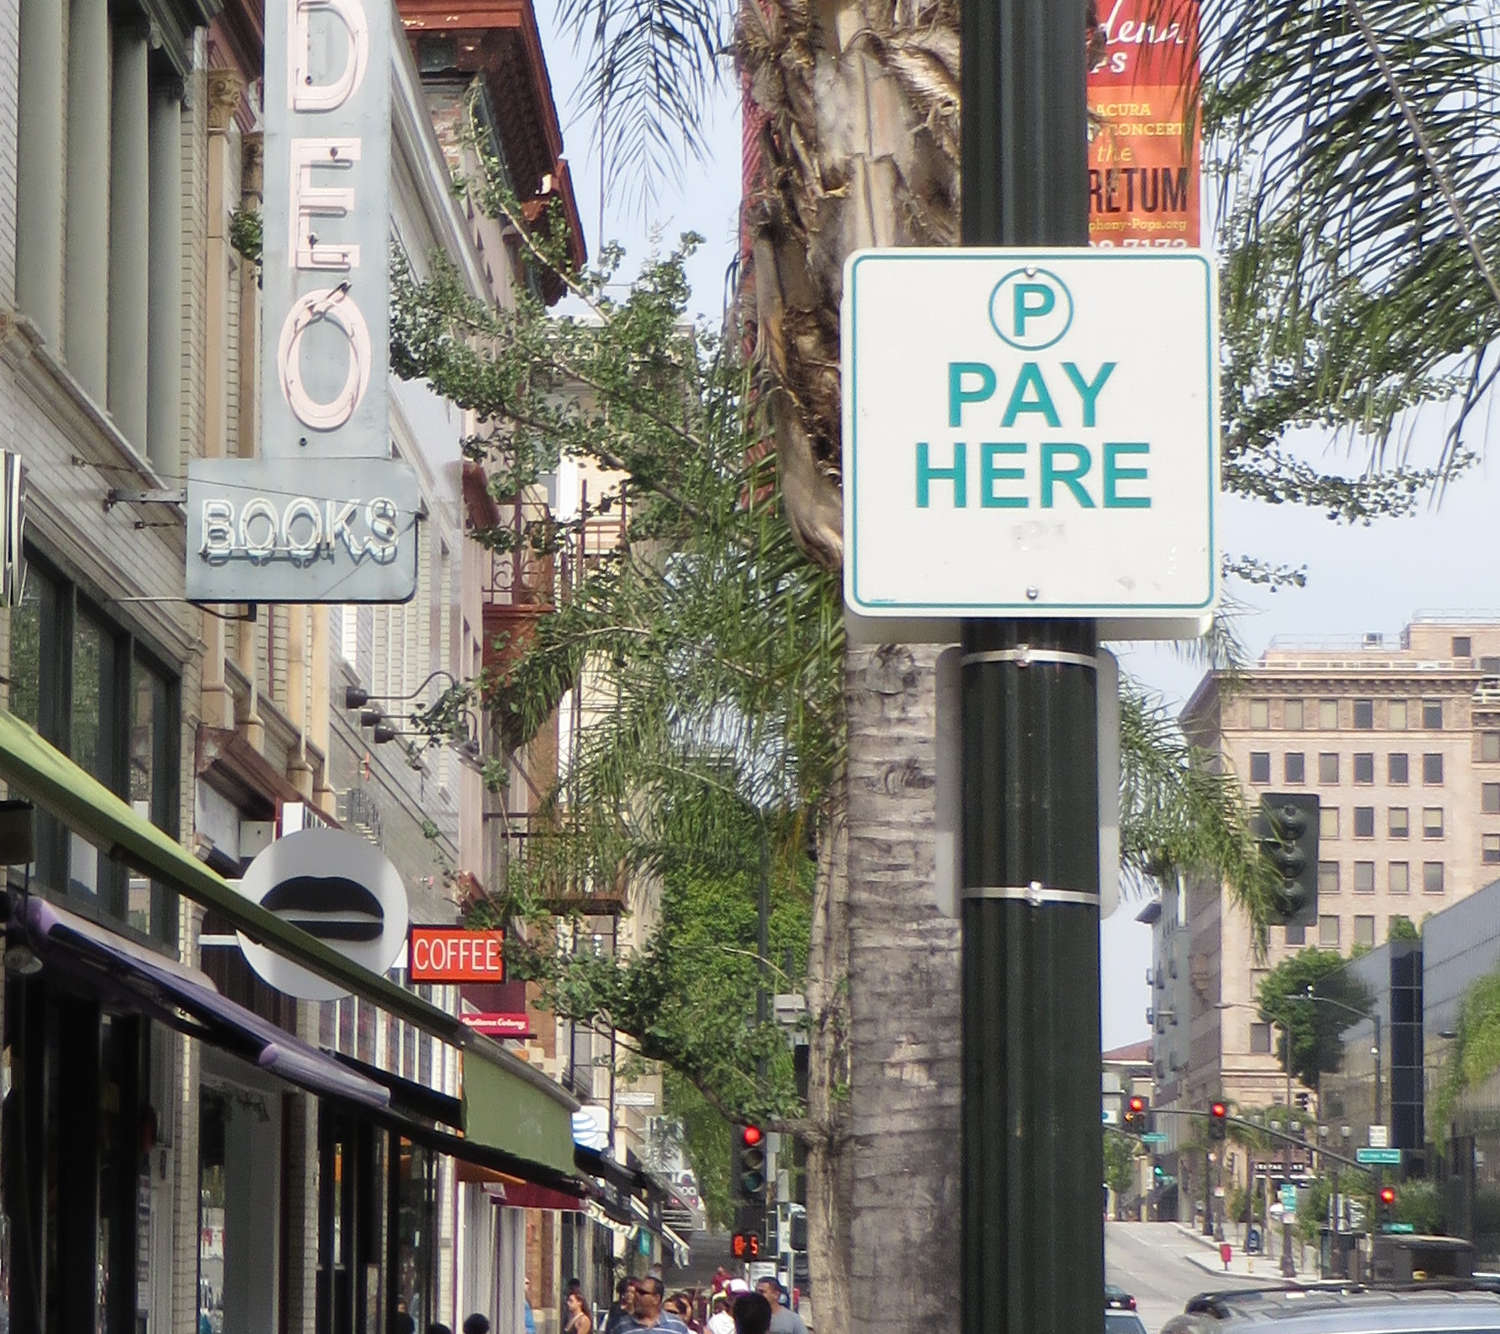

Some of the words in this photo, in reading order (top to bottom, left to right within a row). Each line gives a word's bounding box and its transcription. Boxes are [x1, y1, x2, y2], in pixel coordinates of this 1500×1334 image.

[1011, 282, 1056, 337] P
[947, 361, 1118, 429] PAY
[914, 442, 1152, 509] HERE
[200, 496, 399, 564] BOOKS
[413, 938, 500, 970] COFFEE
